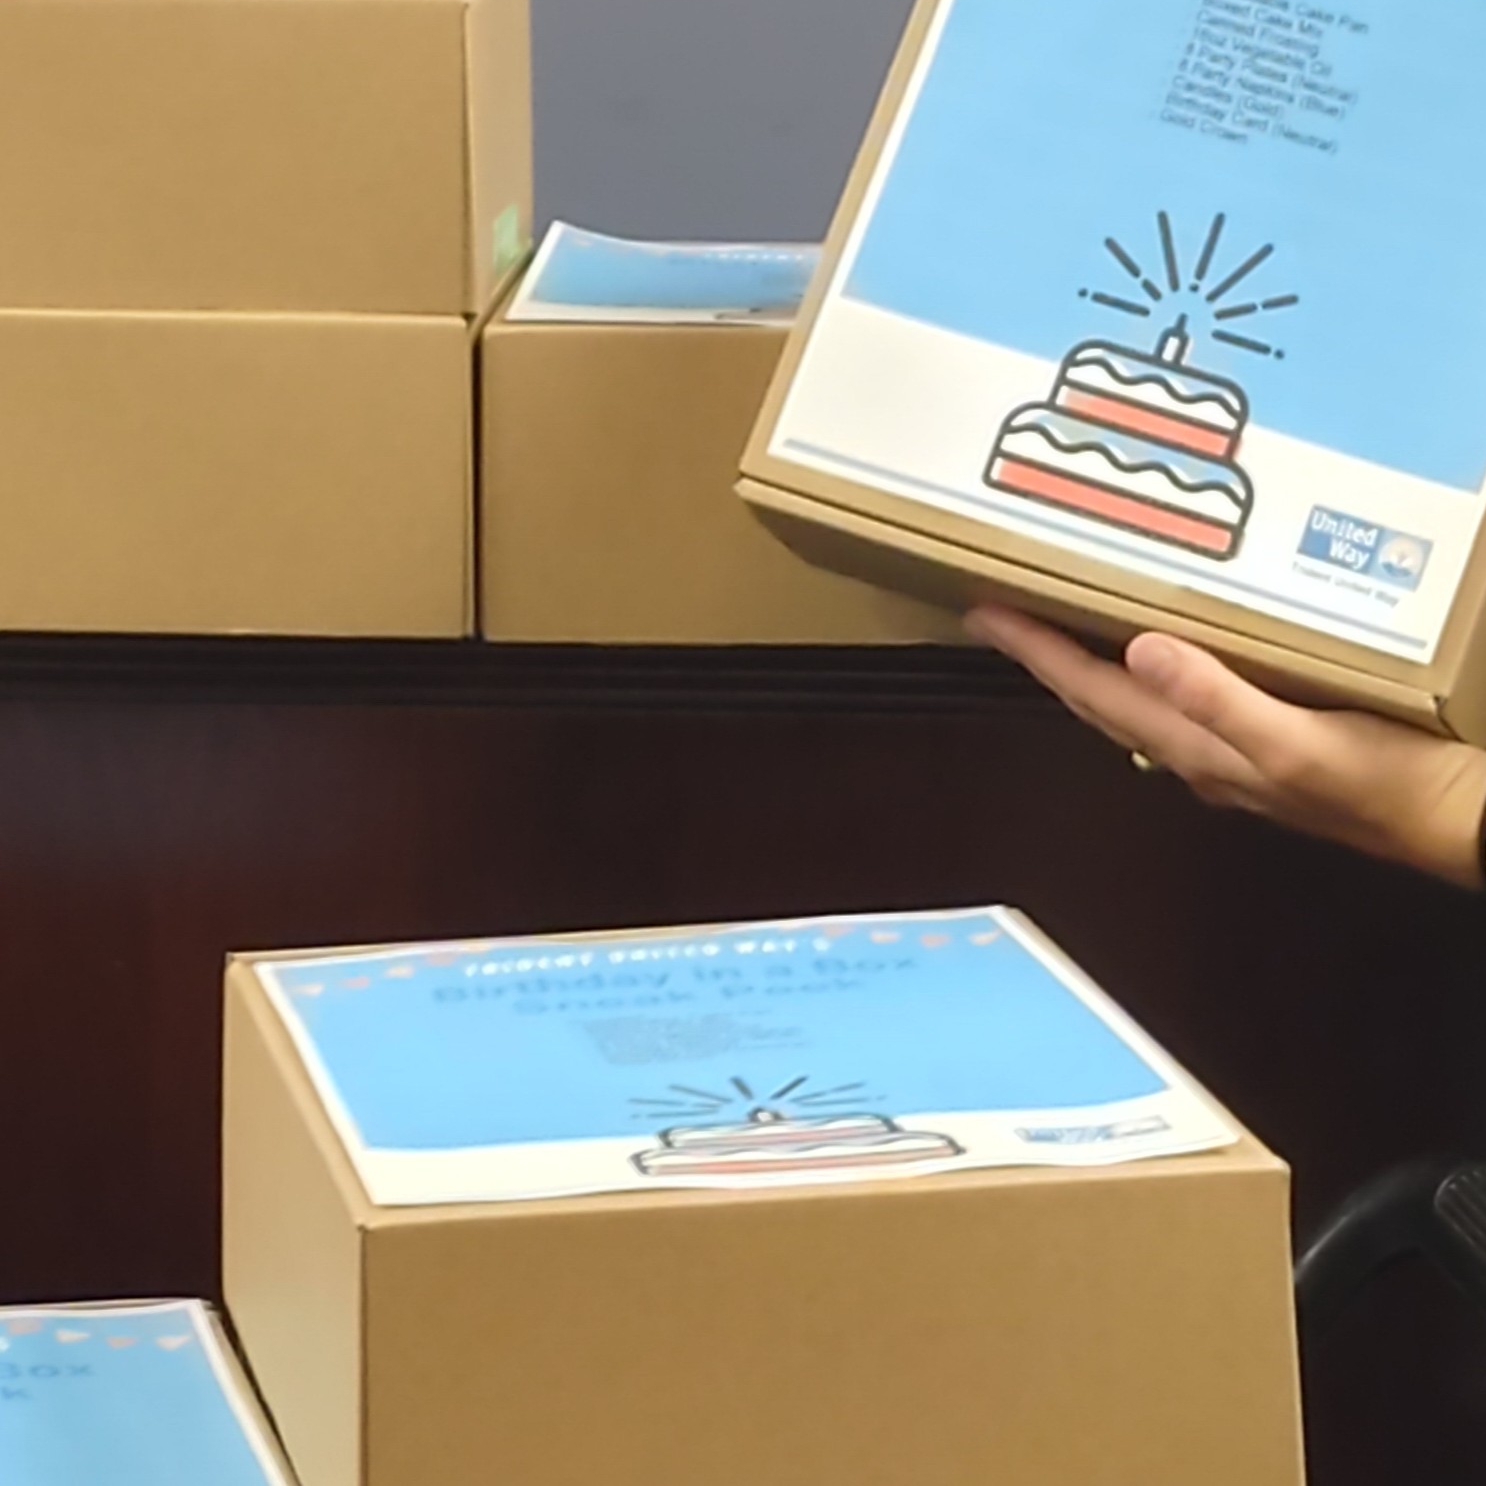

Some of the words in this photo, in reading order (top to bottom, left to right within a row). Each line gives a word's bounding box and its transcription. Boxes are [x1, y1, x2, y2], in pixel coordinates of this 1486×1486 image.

[1254, 7, 1292, 28] Cake
[1296, 2, 1335, 24] Cake
[1197, 45, 1234, 69] Party
[1192, 61, 1229, 85] Party
[1311, 510, 1378, 547] United
[1329, 538, 1370, 570] Way
